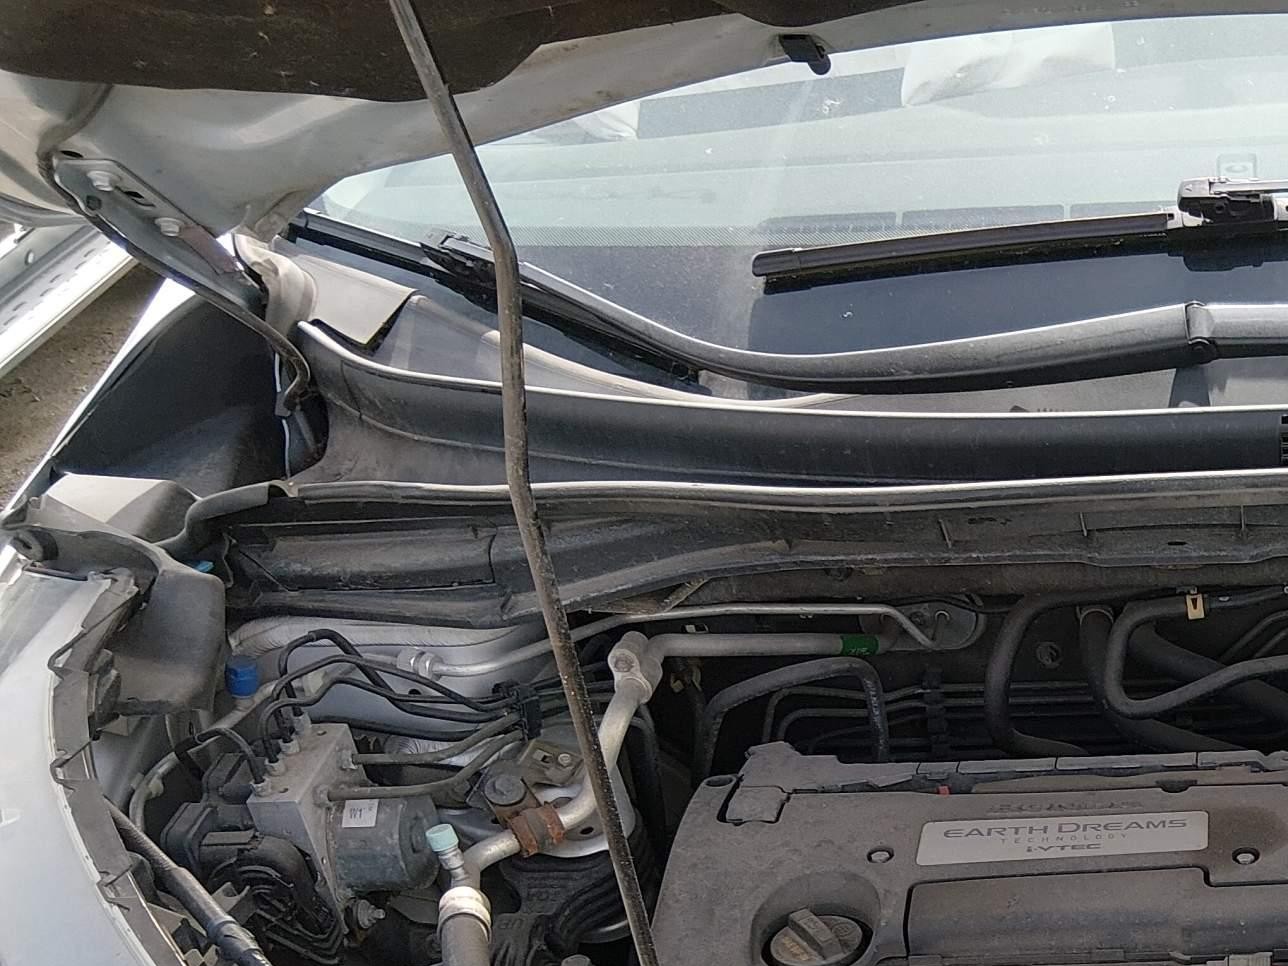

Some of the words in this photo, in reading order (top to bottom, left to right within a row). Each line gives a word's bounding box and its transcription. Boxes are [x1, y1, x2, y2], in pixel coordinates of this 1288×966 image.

[944, 826, 1048, 838] EARTH
[1058, 819, 1187, 833] DREAMS
[1000, 834, 1128, 843] TECHNOLOGY
